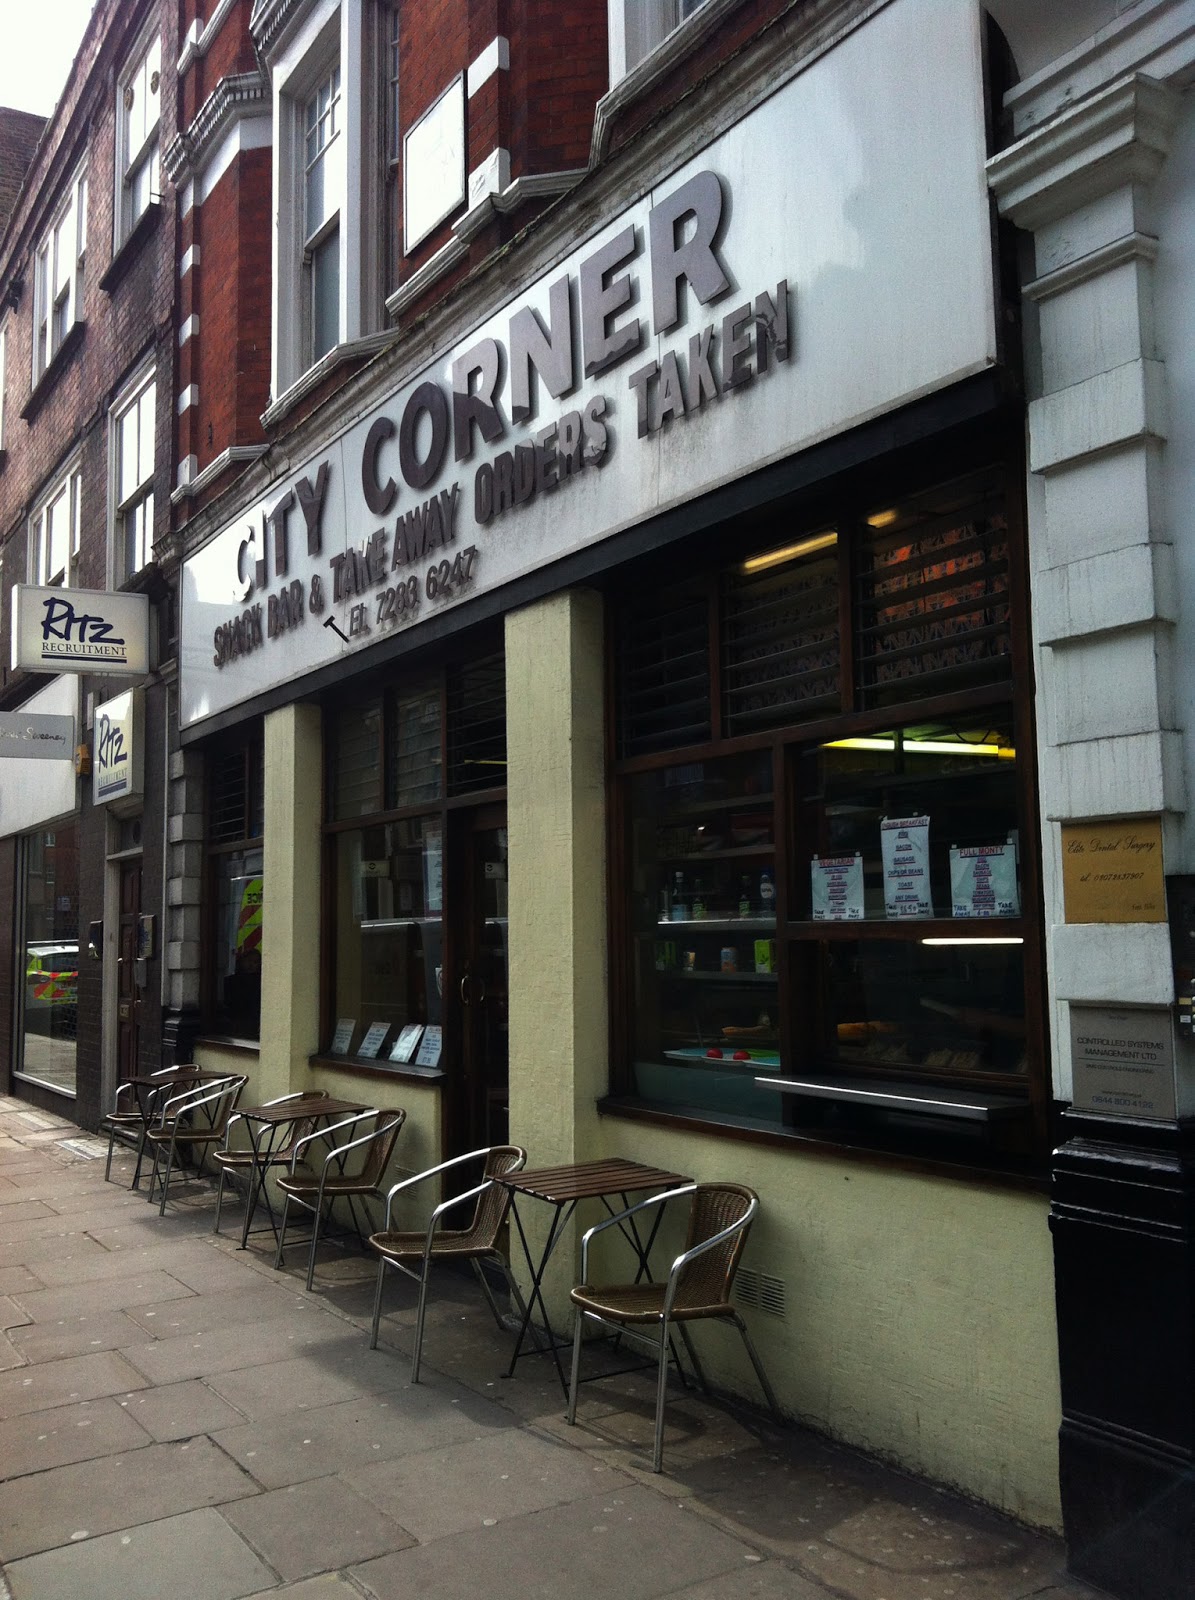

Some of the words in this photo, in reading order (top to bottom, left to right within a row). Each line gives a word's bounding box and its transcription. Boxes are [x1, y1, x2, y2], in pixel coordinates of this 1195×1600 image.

[232, 460, 329, 602] CITY
[362, 170, 731, 515] CORNER
[213, 602, 263, 667] SNACK
[268, 579, 304, 638] BAR
[309, 574, 324, 614] &
[329, 527, 387, 604] TAKE
[391, 481, 461, 573] AWAY
[474, 395, 608, 525] ORDERS
[628, 279, 789, 440] TAKEN
[376, 575, 420, 625] 7283
[426, 545, 478, 600] 6247
[42, 642, 127, 656] RECRUITMENT
[960, 848, 977, 856] FULL
[978, 845, 1004, 855] MONTY
[1090, 838, 1121, 852] Dental
[1123, 835, 1156, 854] Surgery
[1077, 1037, 1126, 1048] CONTROLLED
[1127, 1040, 1165, 1051] SYSTEMS
[1085, 1048, 1140, 1059] MANAGEMENT
[1141, 1053, 1157, 1061] LTD
